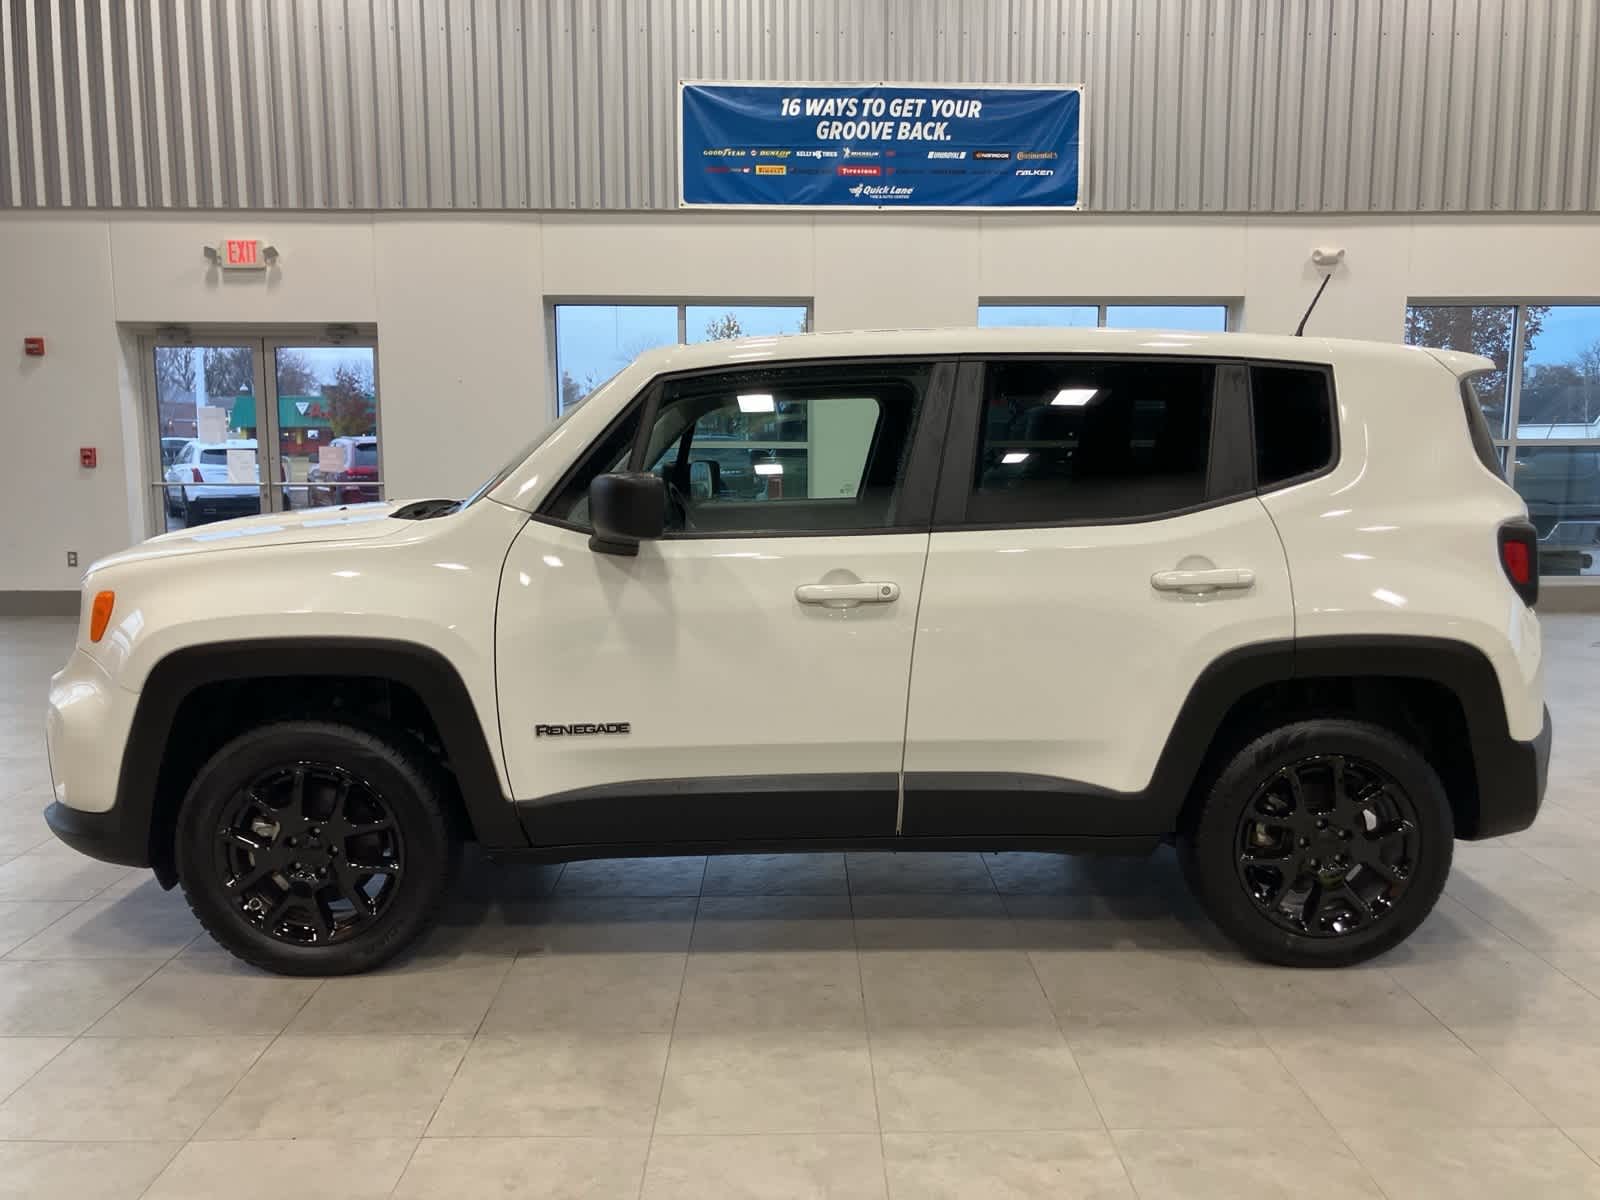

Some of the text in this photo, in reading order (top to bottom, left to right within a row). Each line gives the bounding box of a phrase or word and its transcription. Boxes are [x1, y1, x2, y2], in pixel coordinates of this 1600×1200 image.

[781, 98, 982, 119] 16 WAYS TO GET YOUR
[816, 121, 952, 141] GROOVE BACK.
[863, 185, 914, 195] Quick Lane
[227, 240, 257, 264] EXIT
[535, 722, 631, 737] RENEGADE
